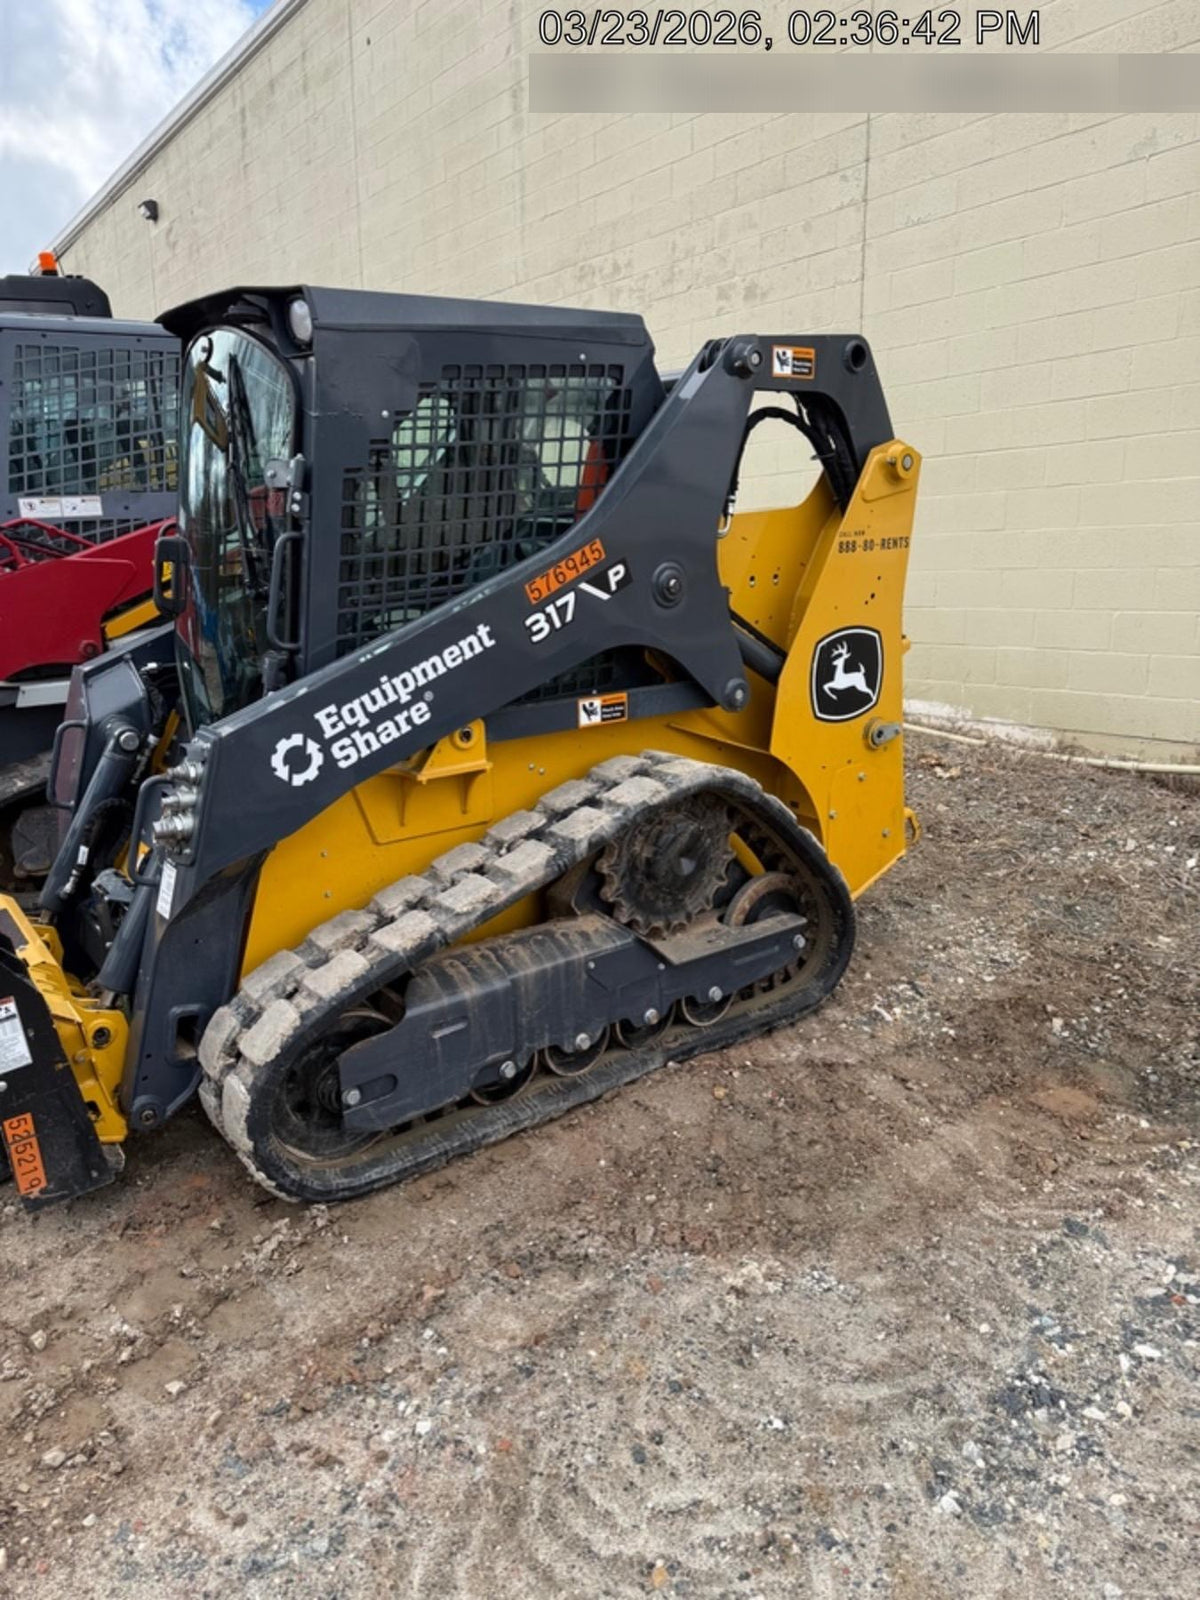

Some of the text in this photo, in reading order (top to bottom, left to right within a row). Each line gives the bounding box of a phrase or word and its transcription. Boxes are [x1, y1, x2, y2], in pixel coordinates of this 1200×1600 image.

[527, 541, 603, 601] 576945
[838, 536, 909, 554] 888-80-RENTS
[524, 563, 625, 643] 317 P
[313, 623, 496, 739] Equipment
[330, 700, 432, 769] Share
[8, 1117, 41, 1191] 525219
